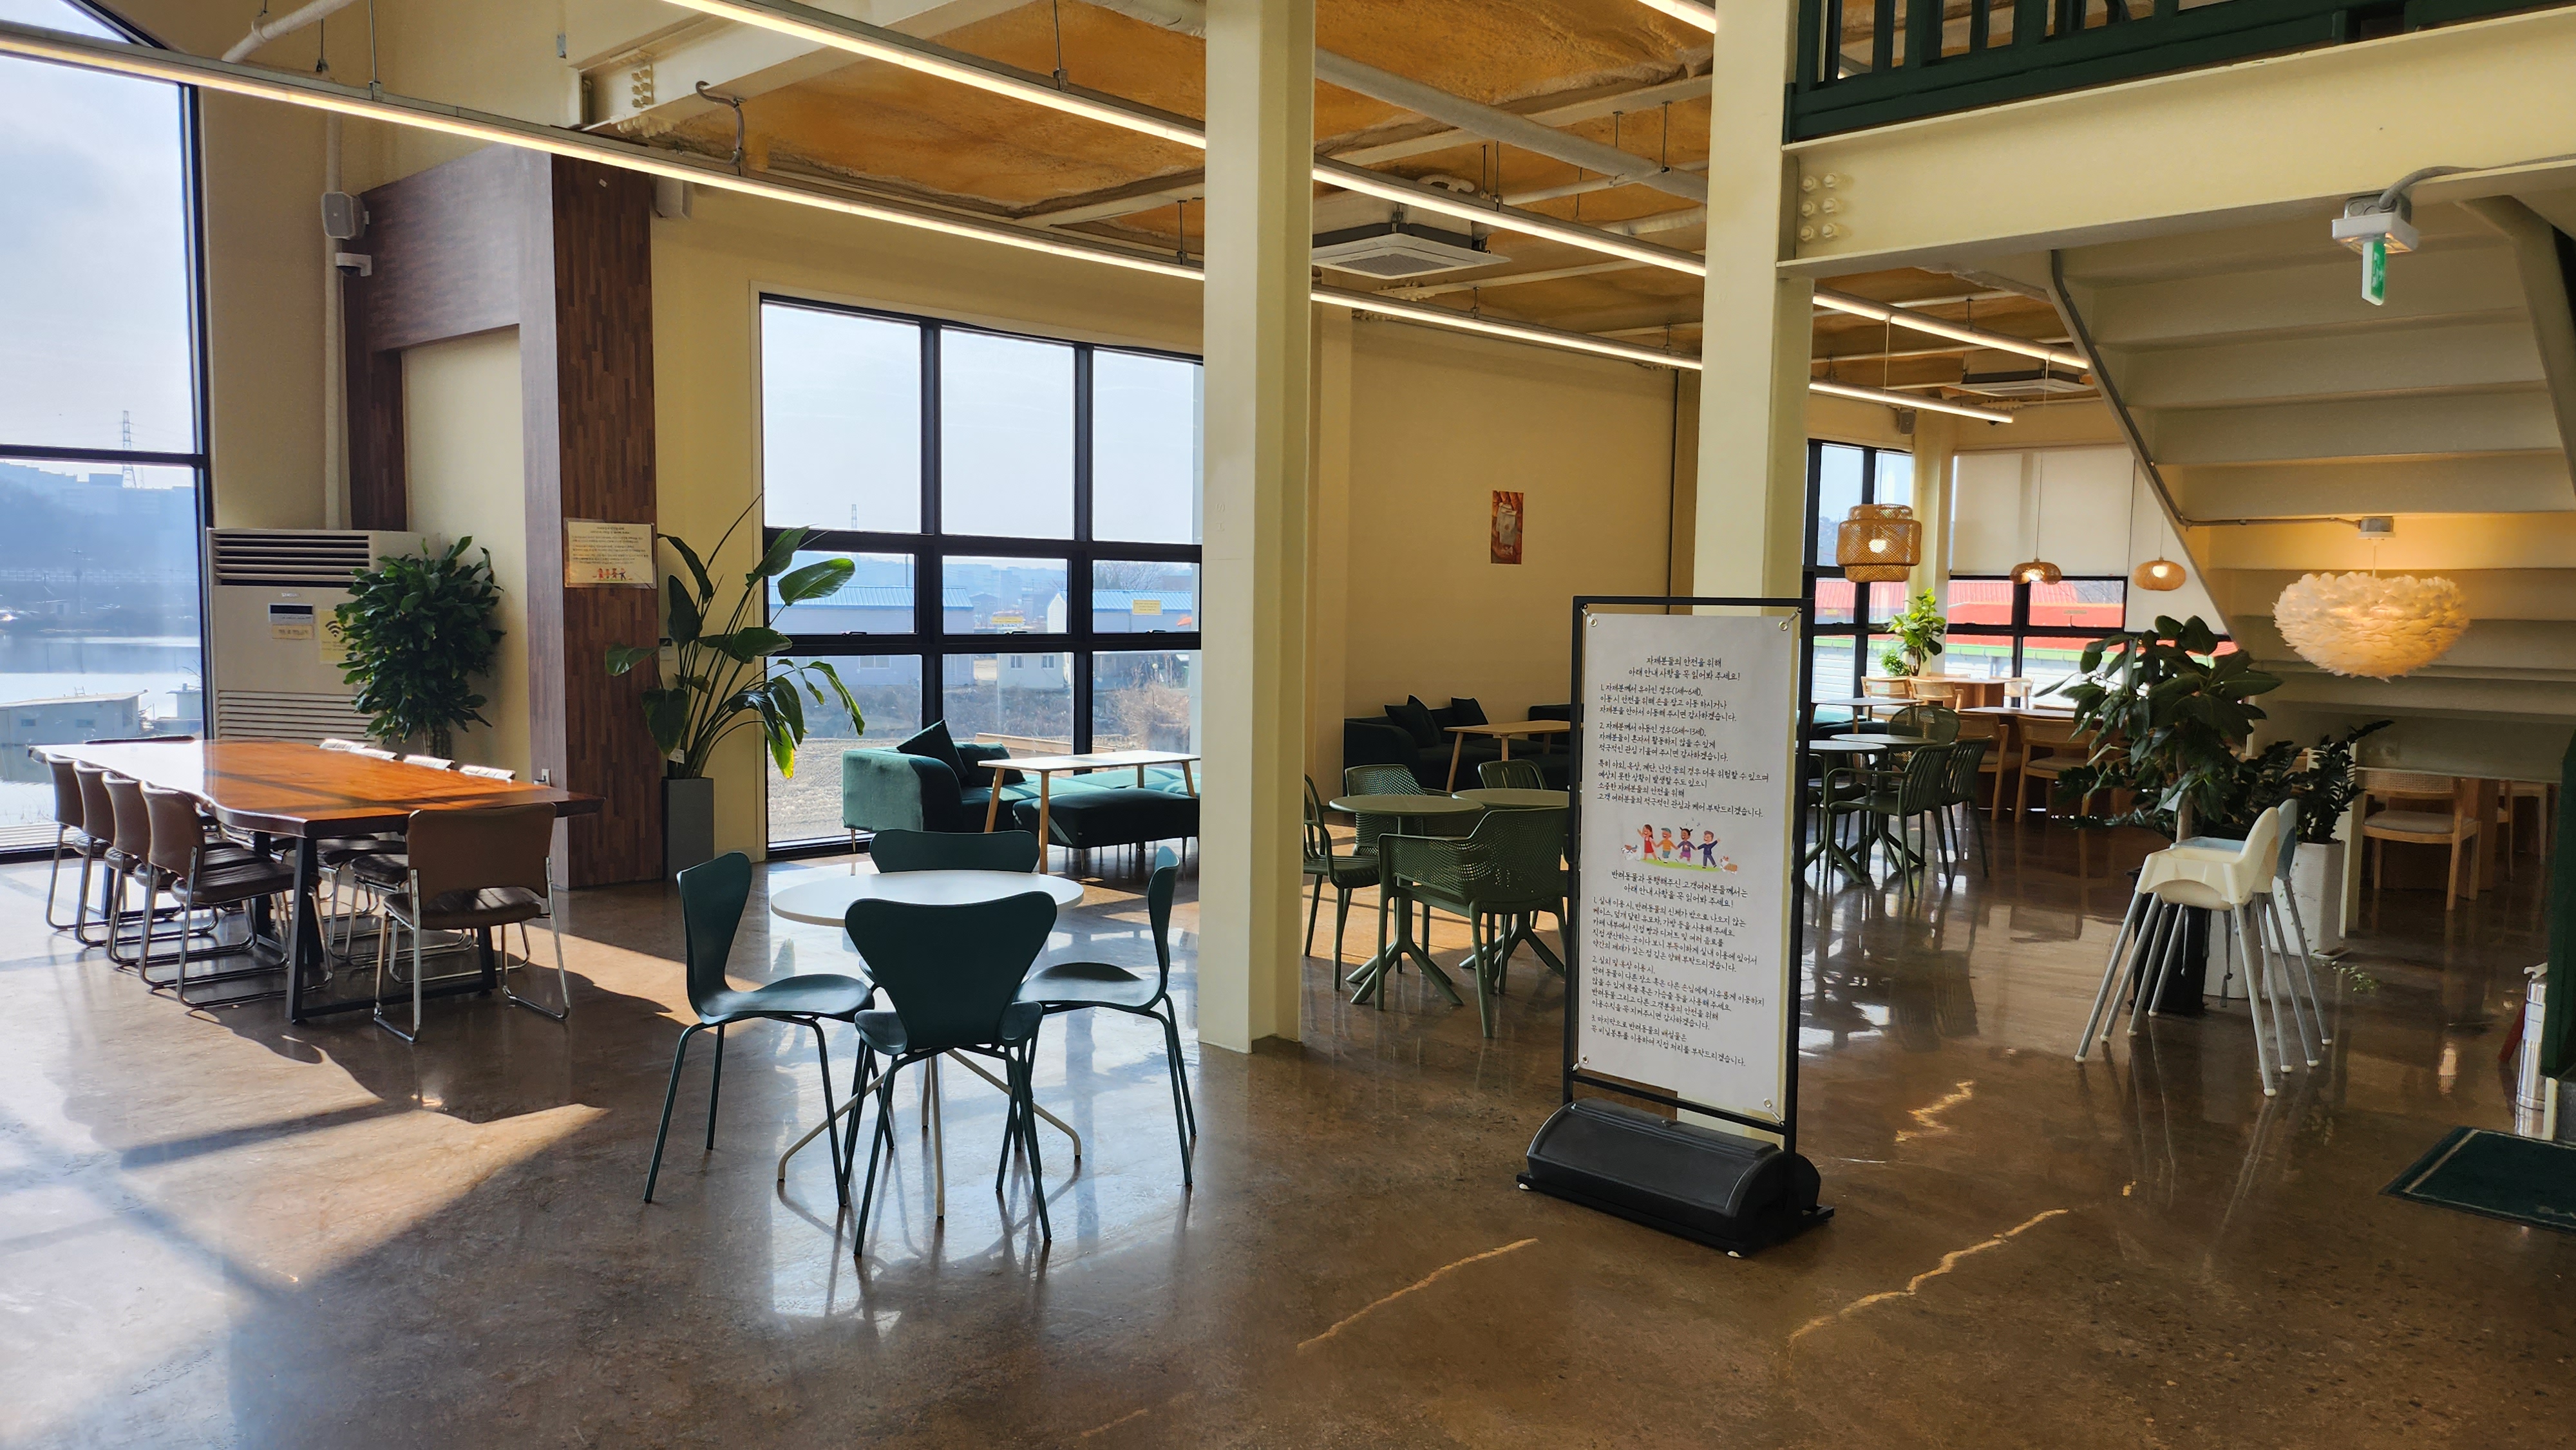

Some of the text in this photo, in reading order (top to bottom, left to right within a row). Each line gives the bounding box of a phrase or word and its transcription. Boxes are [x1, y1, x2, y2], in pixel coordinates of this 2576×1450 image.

[1647, 655, 1721, 667] 자제분들의 안전을 위해
[1629, 668, 1642, 676] 아래
[1692, 670, 1713, 680] 읽어봐
[1715, 671, 1740, 681] 주세요!
[1606, 684, 1636, 692] 자제분께서
[1638, 685, 1657, 693] 유아인
[1600, 694, 1612, 702] 이동
[1622, 696, 1640, 704] 안전을
[1656, 698, 1669, 706] 손을
[1671, 698, 1683, 707] 잡고
[1600, 706, 1736, 722] 자제분을 안아서 이동해 주시면 감사하겠습니다.
[1606, 721, 1636, 730] 자제분께서
[1638, 723, 1657, 733] 아동인
[1599, 732, 1629, 742] 자제분들이
[1631, 735, 1649, 743] 혼자서
[1652, 736, 1677, 746] 활동하지
[1680, 739, 1692, 747] 않을
[1702, 740, 1715, 749] 있게
[1599, 743, 1728, 761] 적극적인 관심 기울여 주시면 감사하겠습니다.
[1598, 759, 1610, 768] 특히
[1613, 760, 1625, 769] 야외,
[1627, 762, 1641, 771] 옥상,
[1659, 764, 1671, 773] 난간
[1673, 766, 1685, 775] 등의
[1688, 766, 1700, 776] 경우
[1703, 767, 1716, 777] 더욱
[1718, 769, 1738, 779] 위험할
[1739, 772, 1747, 780] 수
[1748, 773, 1769, 782] 있으며
[1598, 771, 1616, 780] 예상치
[1618, 772, 1630, 780] 못한
[1632, 774, 1651, 783] 상황이
[1653, 775, 1671, 784] 발생할
[1689, 778, 1707, 787] 있으니
[1618, 783, 1648, 794] 자제분들의
[1651, 786, 1669, 796] 안전을
[1672, 788, 1684, 797] 위해
[1612, 794, 1642, 804] 여러분들의
[1644, 797, 1669, 807] 적극적인
[1671, 800, 1690, 810] 관심과
[1692, 802, 1705, 811] 케어
[1707, 805, 1763, 818] 부탁드리겠습니다.
[1612, 870, 1644, 882] 반려동물과
[1646, 875, 1680, 888] 동행해주신
[1624, 883, 1637, 894] 아래
[1686, 892, 1707, 904] 읽어봐
[1709, 898, 1733, 907] 주세요!
[1599, 896, 1746, 927] 실내 이용 시, 반려동물의 신체가 밖으로 나오지 않는
[1615, 910, 1712, 933] 덮개 달린 유모차, 가방 등을 사용해
[1593, 917, 1723, 947] 카페 내부에서 직접 빵과 디저트 및 여러 음료를
[1593, 928, 1757, 965] 직접 생산하는 곳이다 보니 부득이하게 실내 이용에 있어서
[1593, 939, 1736, 972] 약간의 제재가 있는 점 깊은 양해 부탁드리겠습니다.
[1599, 956, 1655, 974] 실외 및 옥상 이용 시,
[1592, 966, 1764, 1006] 반려 동물이 다른 장소 혹은 다른 손님에게 자유롭게 이동하지
[1592, 977, 1604, 986] 않을
[1613, 980, 1625, 990] 있게
[1626, 984, 1638, 993] 목줄
[1640, 986, 1653, 996] 혹은
[1654, 989, 1673, 1000] 가슴줄
[1675, 993, 1687, 1003] 등을
[1689, 995, 1709, 1008] 사용해
[1592, 988, 1718, 1021] 반려동물 그리고 다른 고객분들의 안전을 위해
[1592, 998, 1621, 1012] 이용수칙을
[1664, 1013, 1710, 1030] 감사하겠습니다.
[1598, 1015, 1627, 1028] 마지막으로
[1629, 1022, 1660, 1035] 반려동물의
[1598, 1025, 1746, 1066] 비닐봉투를 이용하여 직접 처리를 부탁드리겠습니다.
